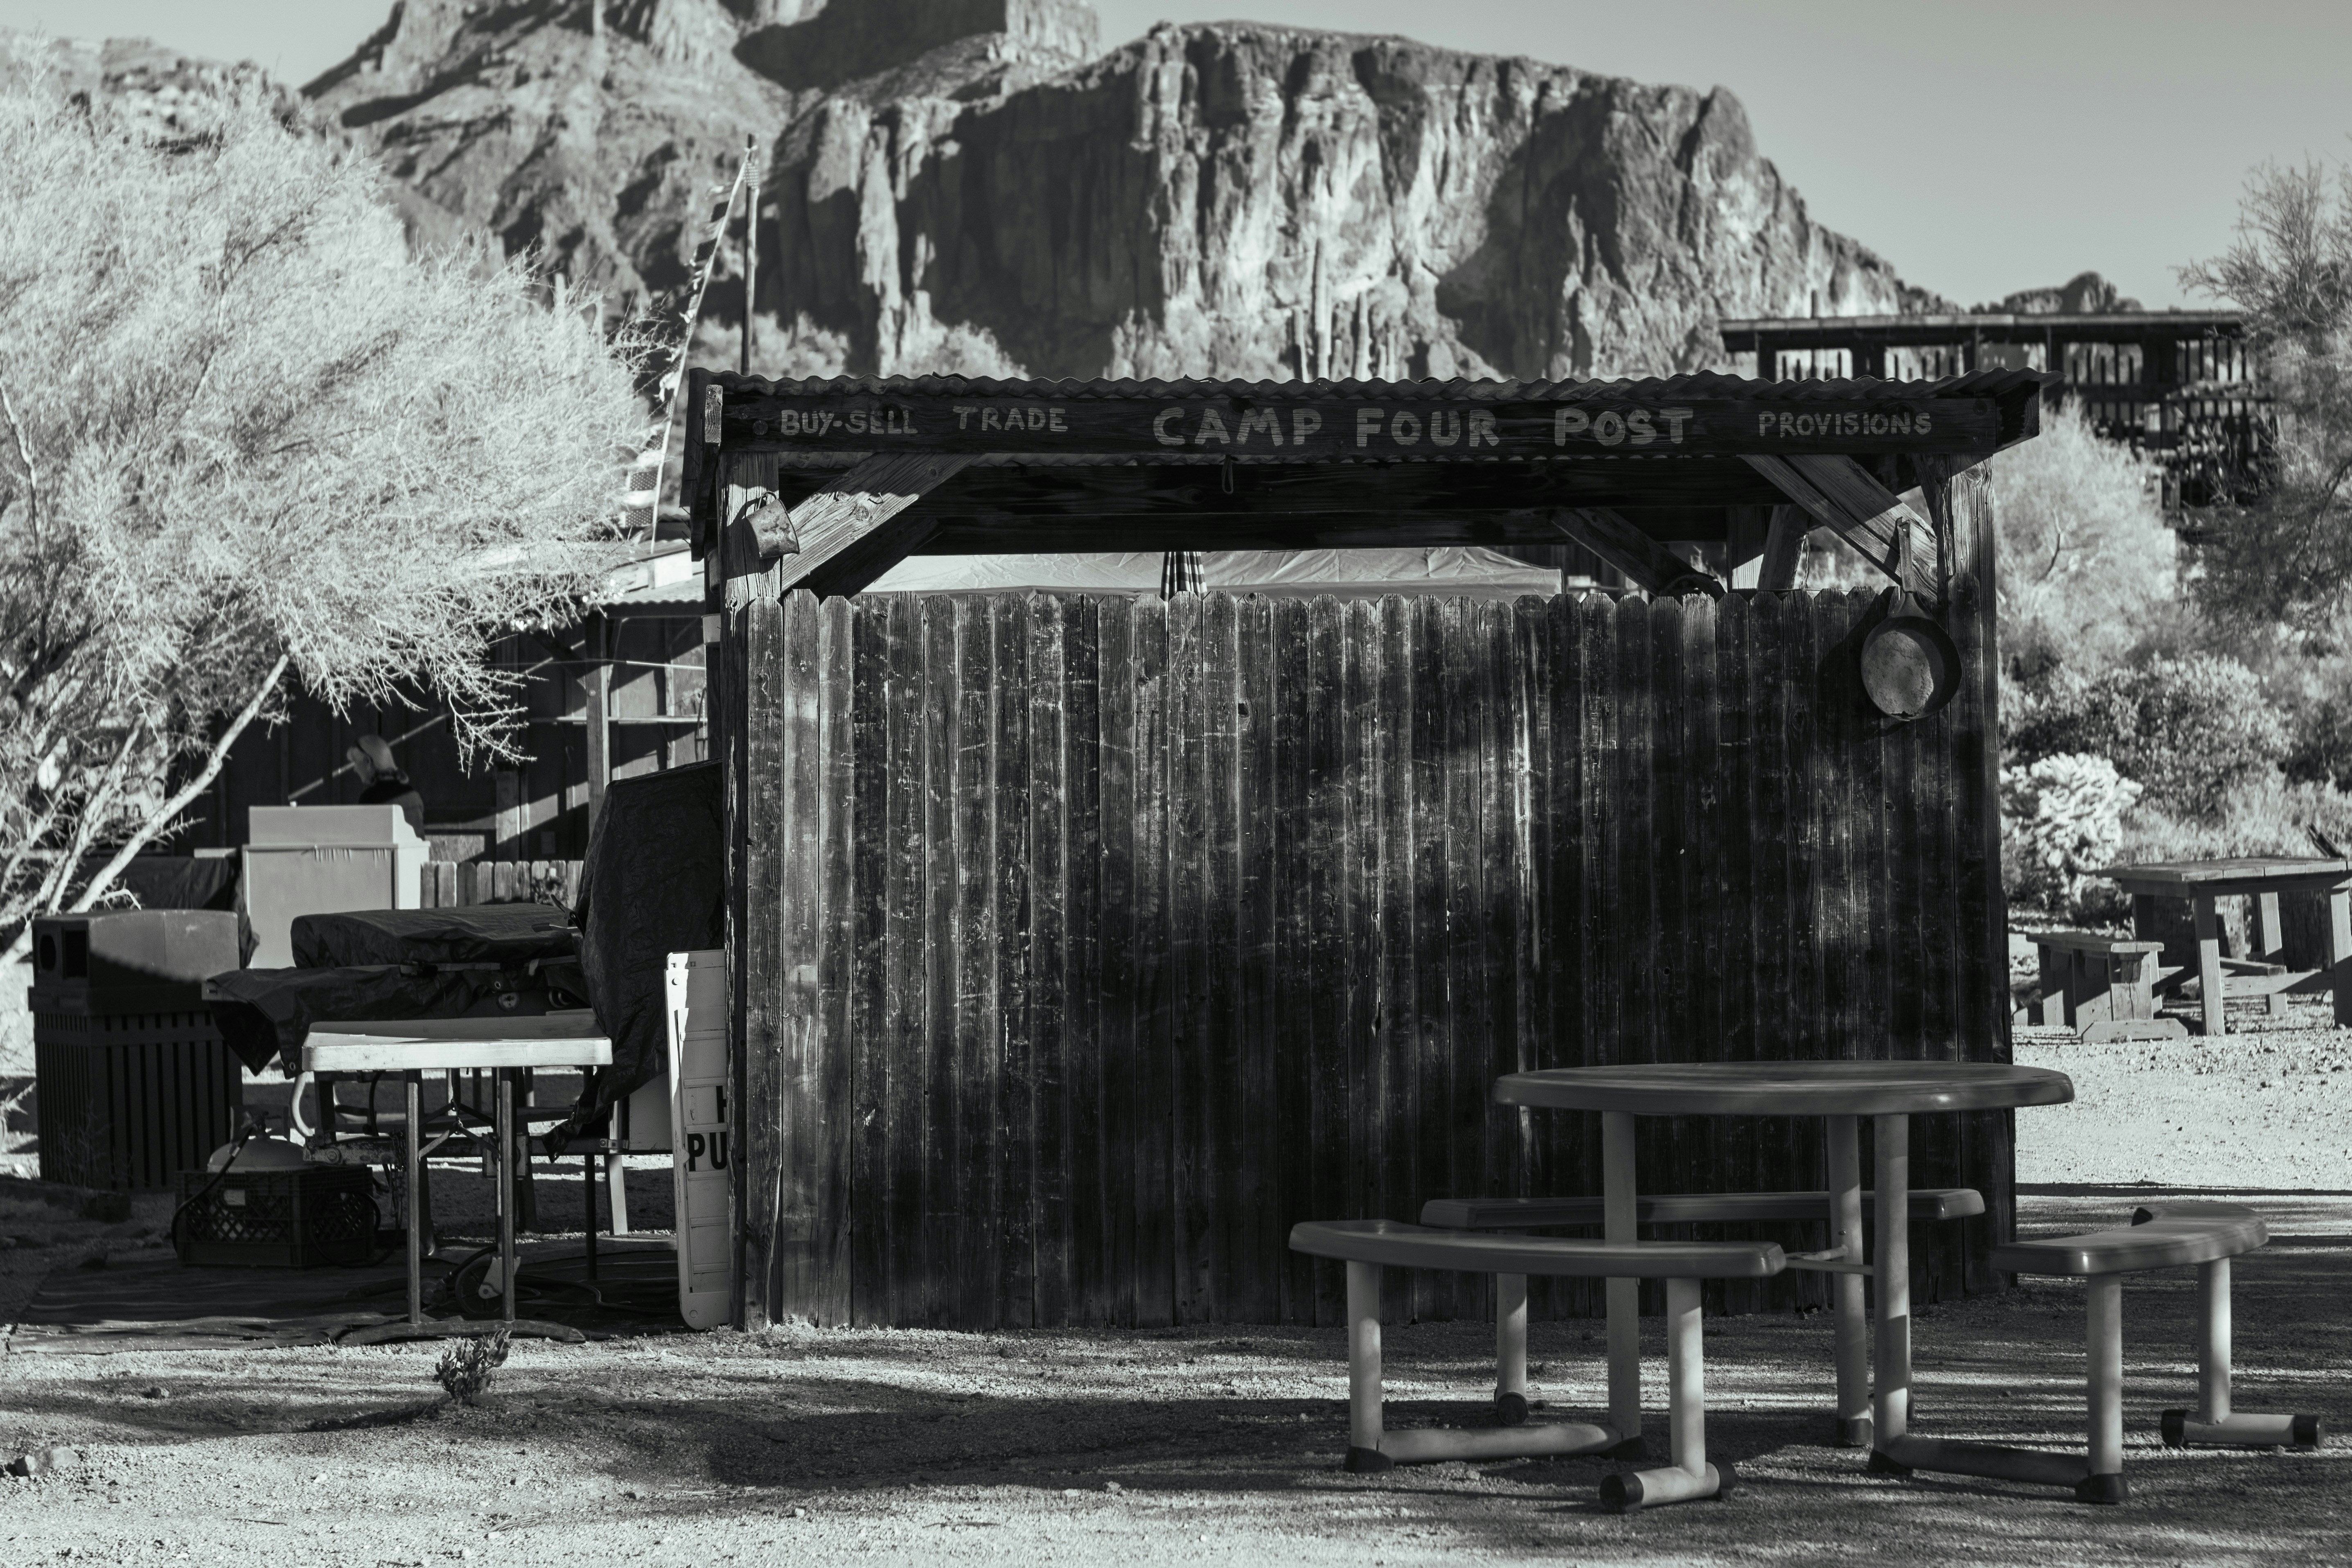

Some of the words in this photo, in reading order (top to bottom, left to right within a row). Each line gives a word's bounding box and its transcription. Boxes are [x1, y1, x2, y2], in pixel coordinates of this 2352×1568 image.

[781, 409, 918, 437] BUY-SELL
[953, 406, 1068, 432] TRADE
[1152, 408, 1323, 447] CAMP
[1356, 408, 1499, 447] FOUR
[1555, 408, 1694, 446] POST
[1759, 411, 1932, 438] PROVISIONS
[687, 1132, 727, 1171] PU
